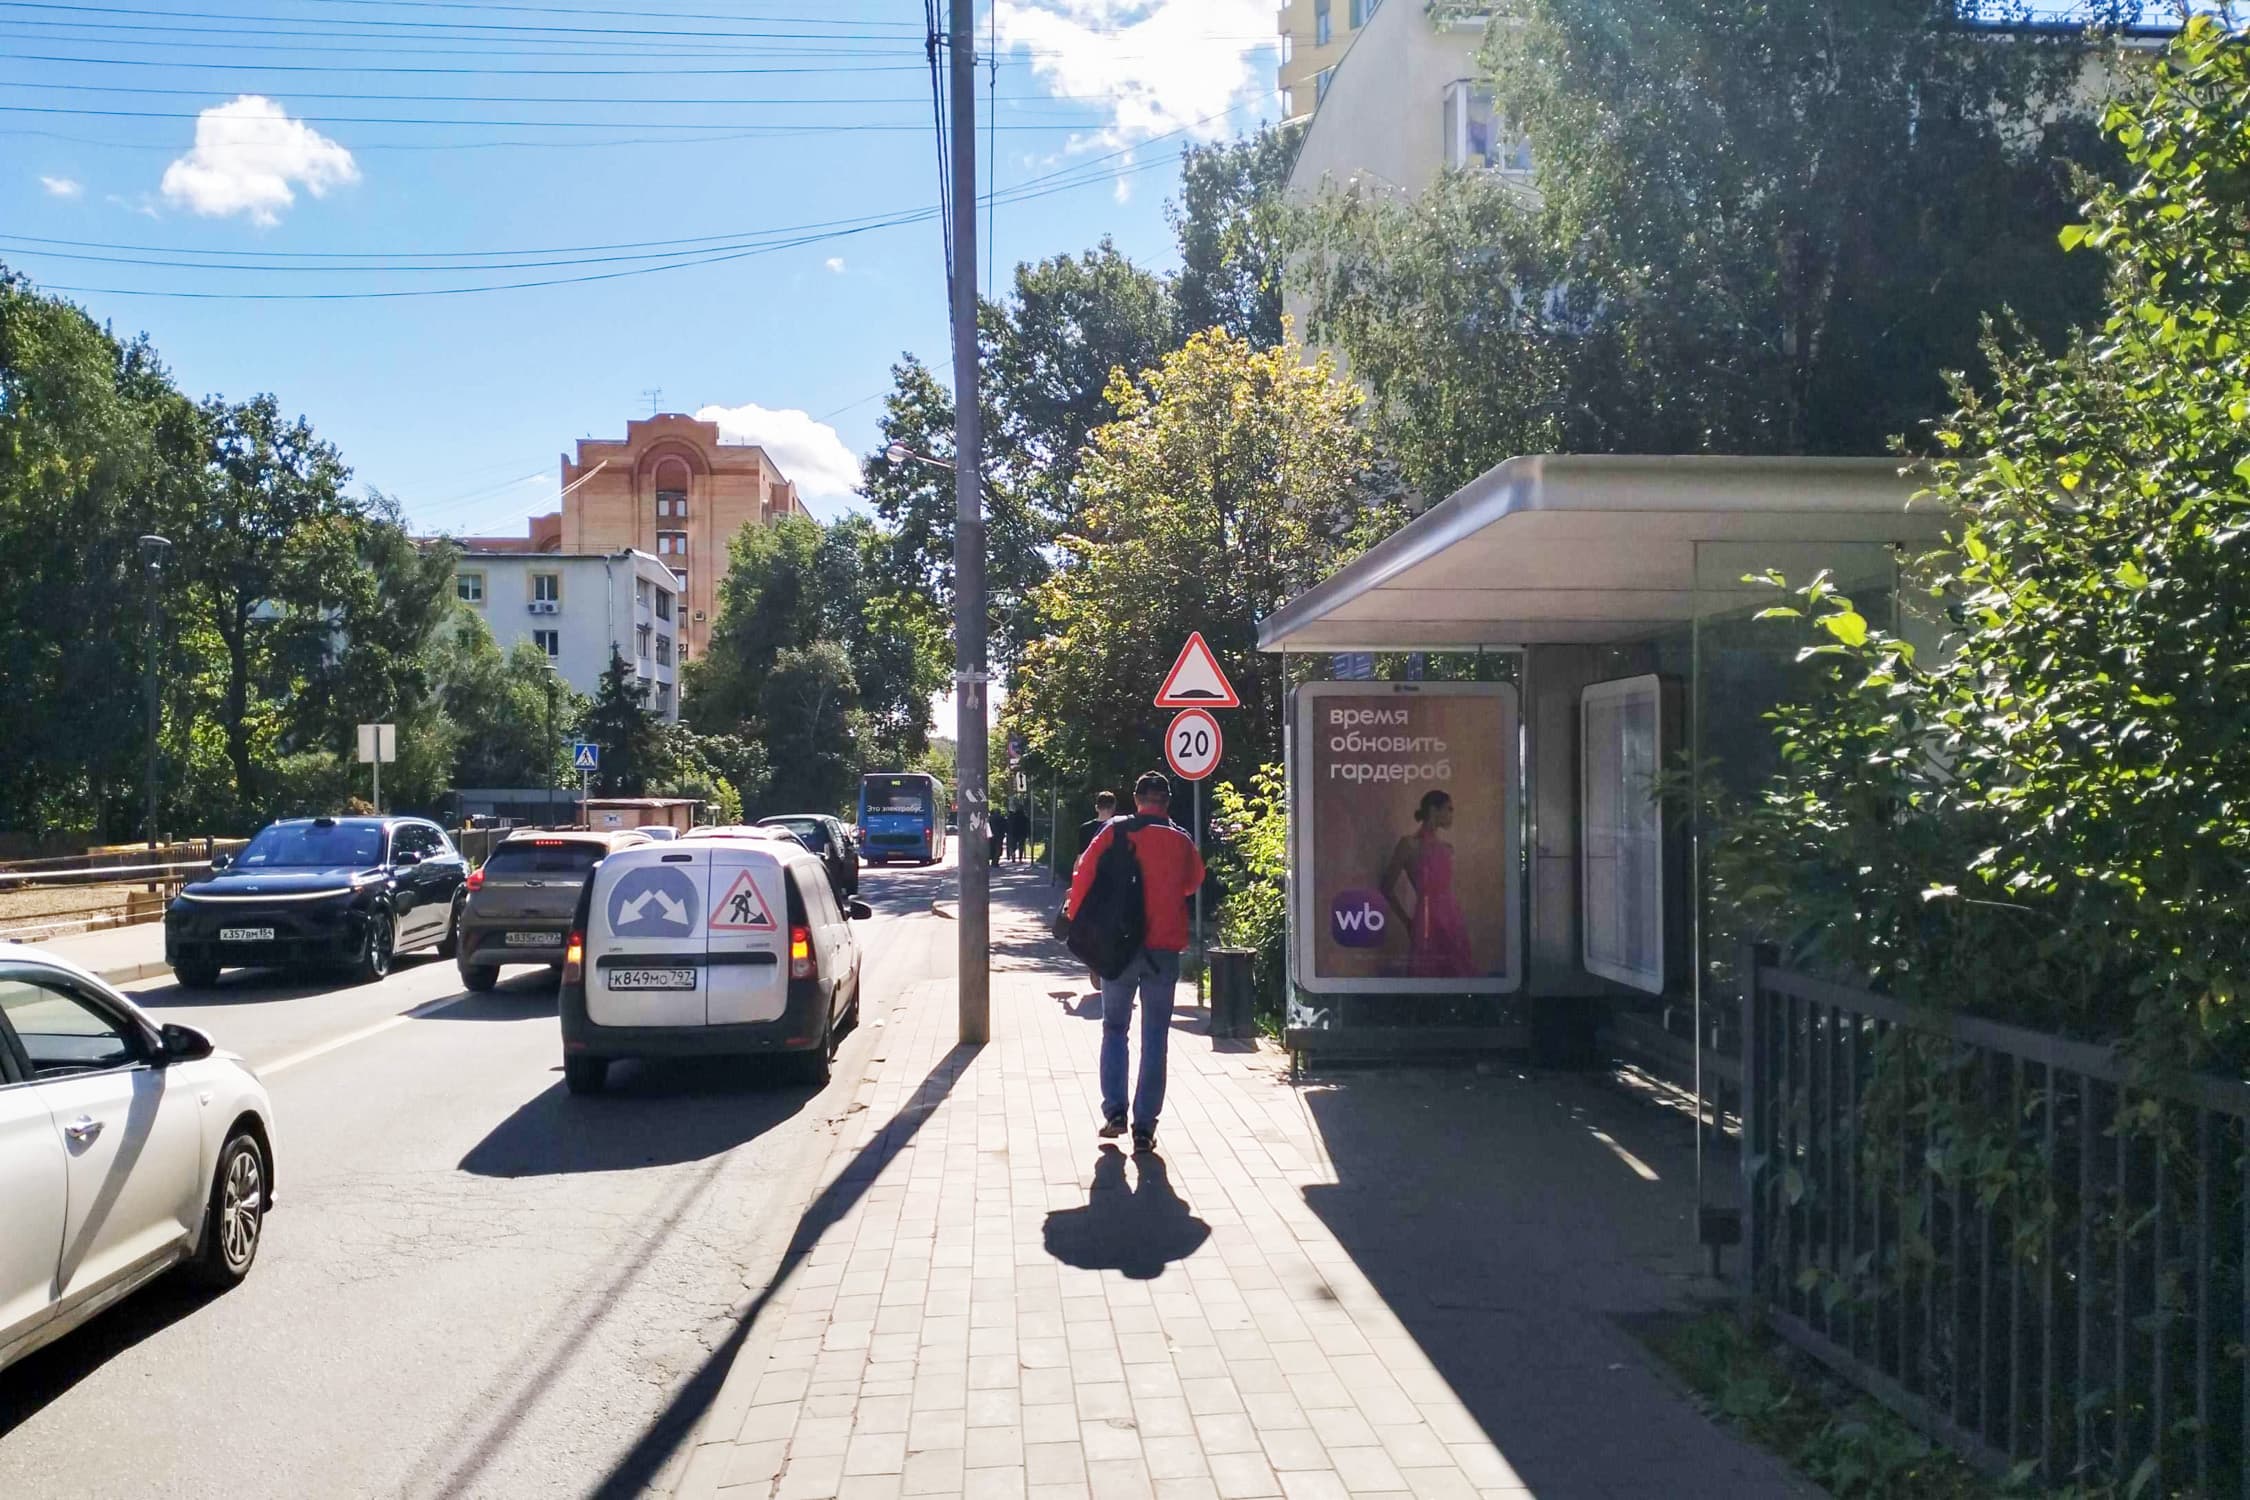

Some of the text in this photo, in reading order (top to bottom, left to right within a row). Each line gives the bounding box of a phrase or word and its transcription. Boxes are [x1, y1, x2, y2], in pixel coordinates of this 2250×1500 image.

[1330, 709, 1408, 729] время
[1179, 731, 1208, 758] 20
[1330, 731, 1447, 752] обновить
[1330, 760, 1451, 784] гардероб
[867, 805, 881, 813] Это
[1335, 902, 1385, 932] wb
